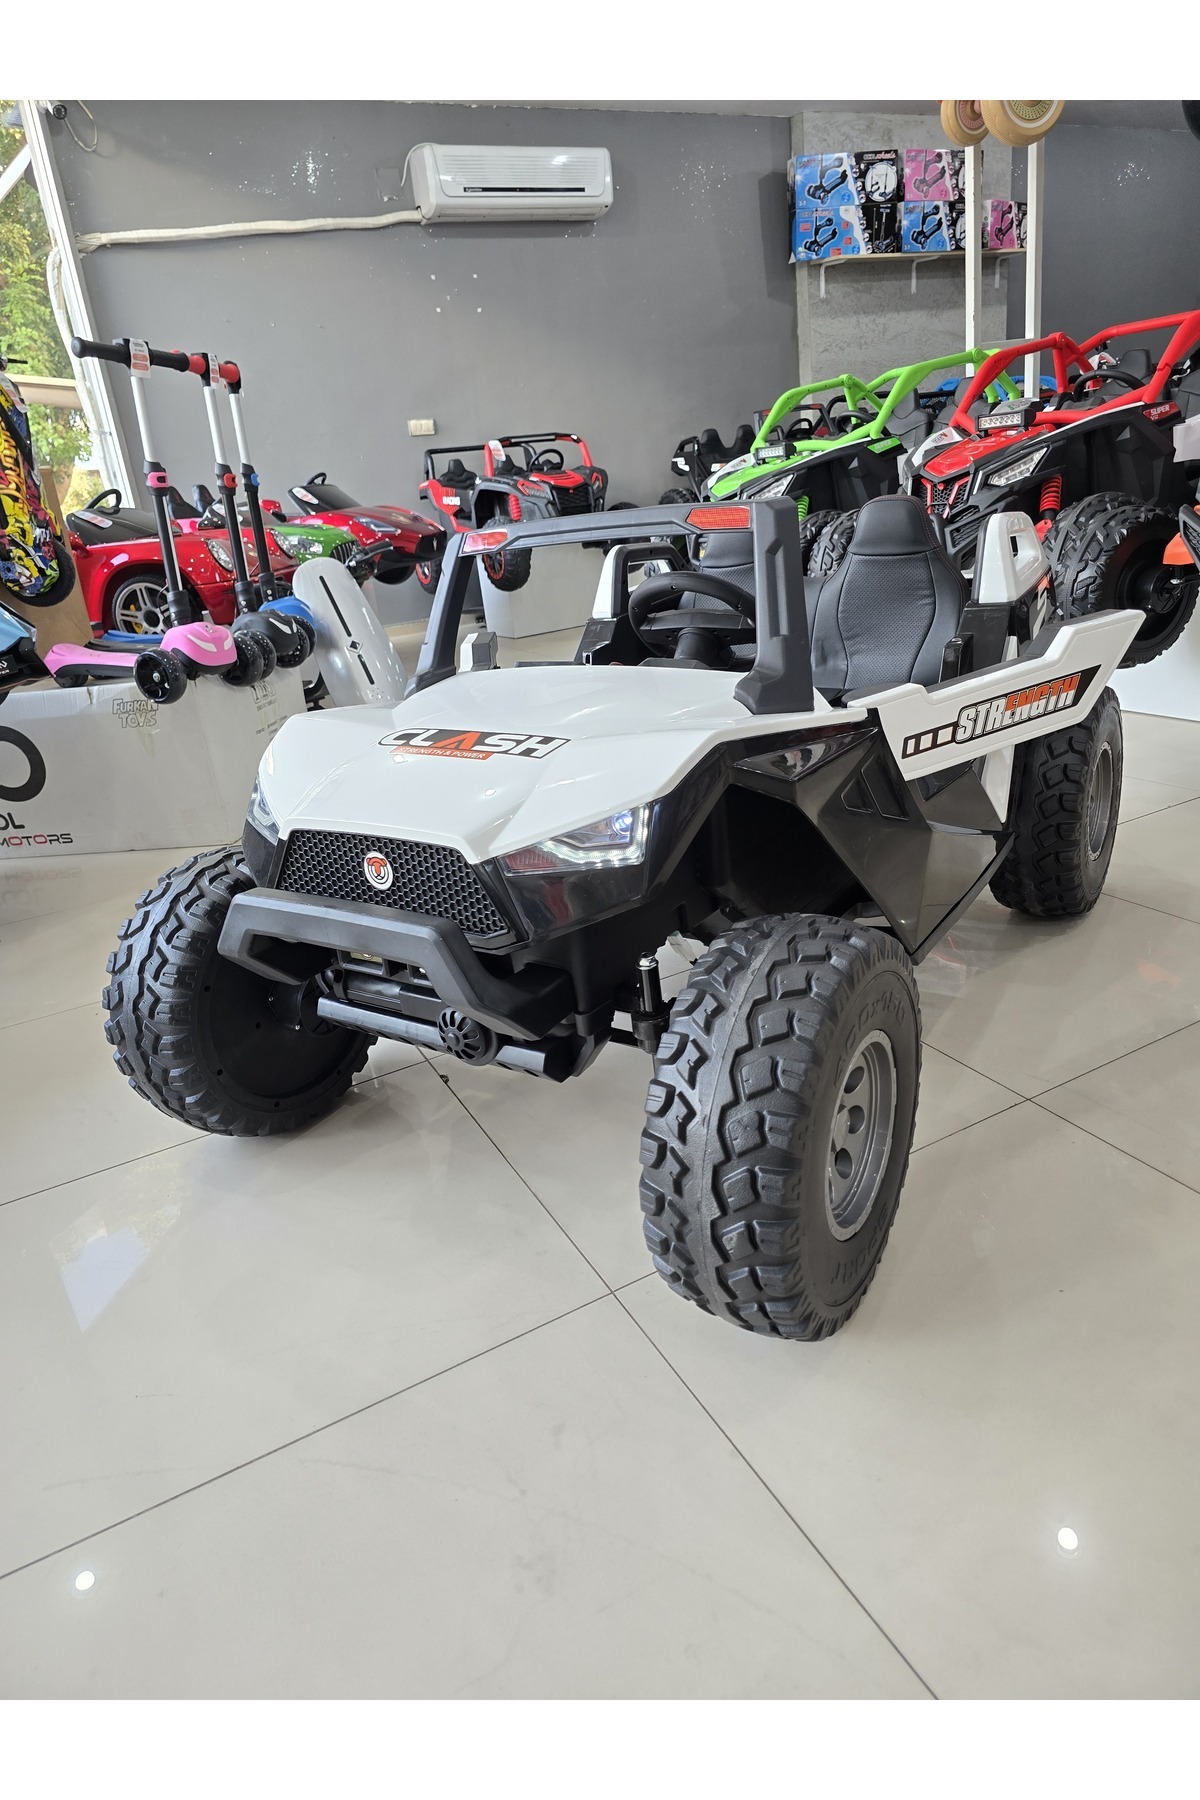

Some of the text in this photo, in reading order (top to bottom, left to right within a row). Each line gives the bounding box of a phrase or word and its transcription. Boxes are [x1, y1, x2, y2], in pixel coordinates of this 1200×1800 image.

[1150, 404, 1170, 416] SUPER
[956, 673, 1081, 743] STRENGTH
[379, 729, 567, 758] CLASH
[452, 750, 486, 759] POWER
